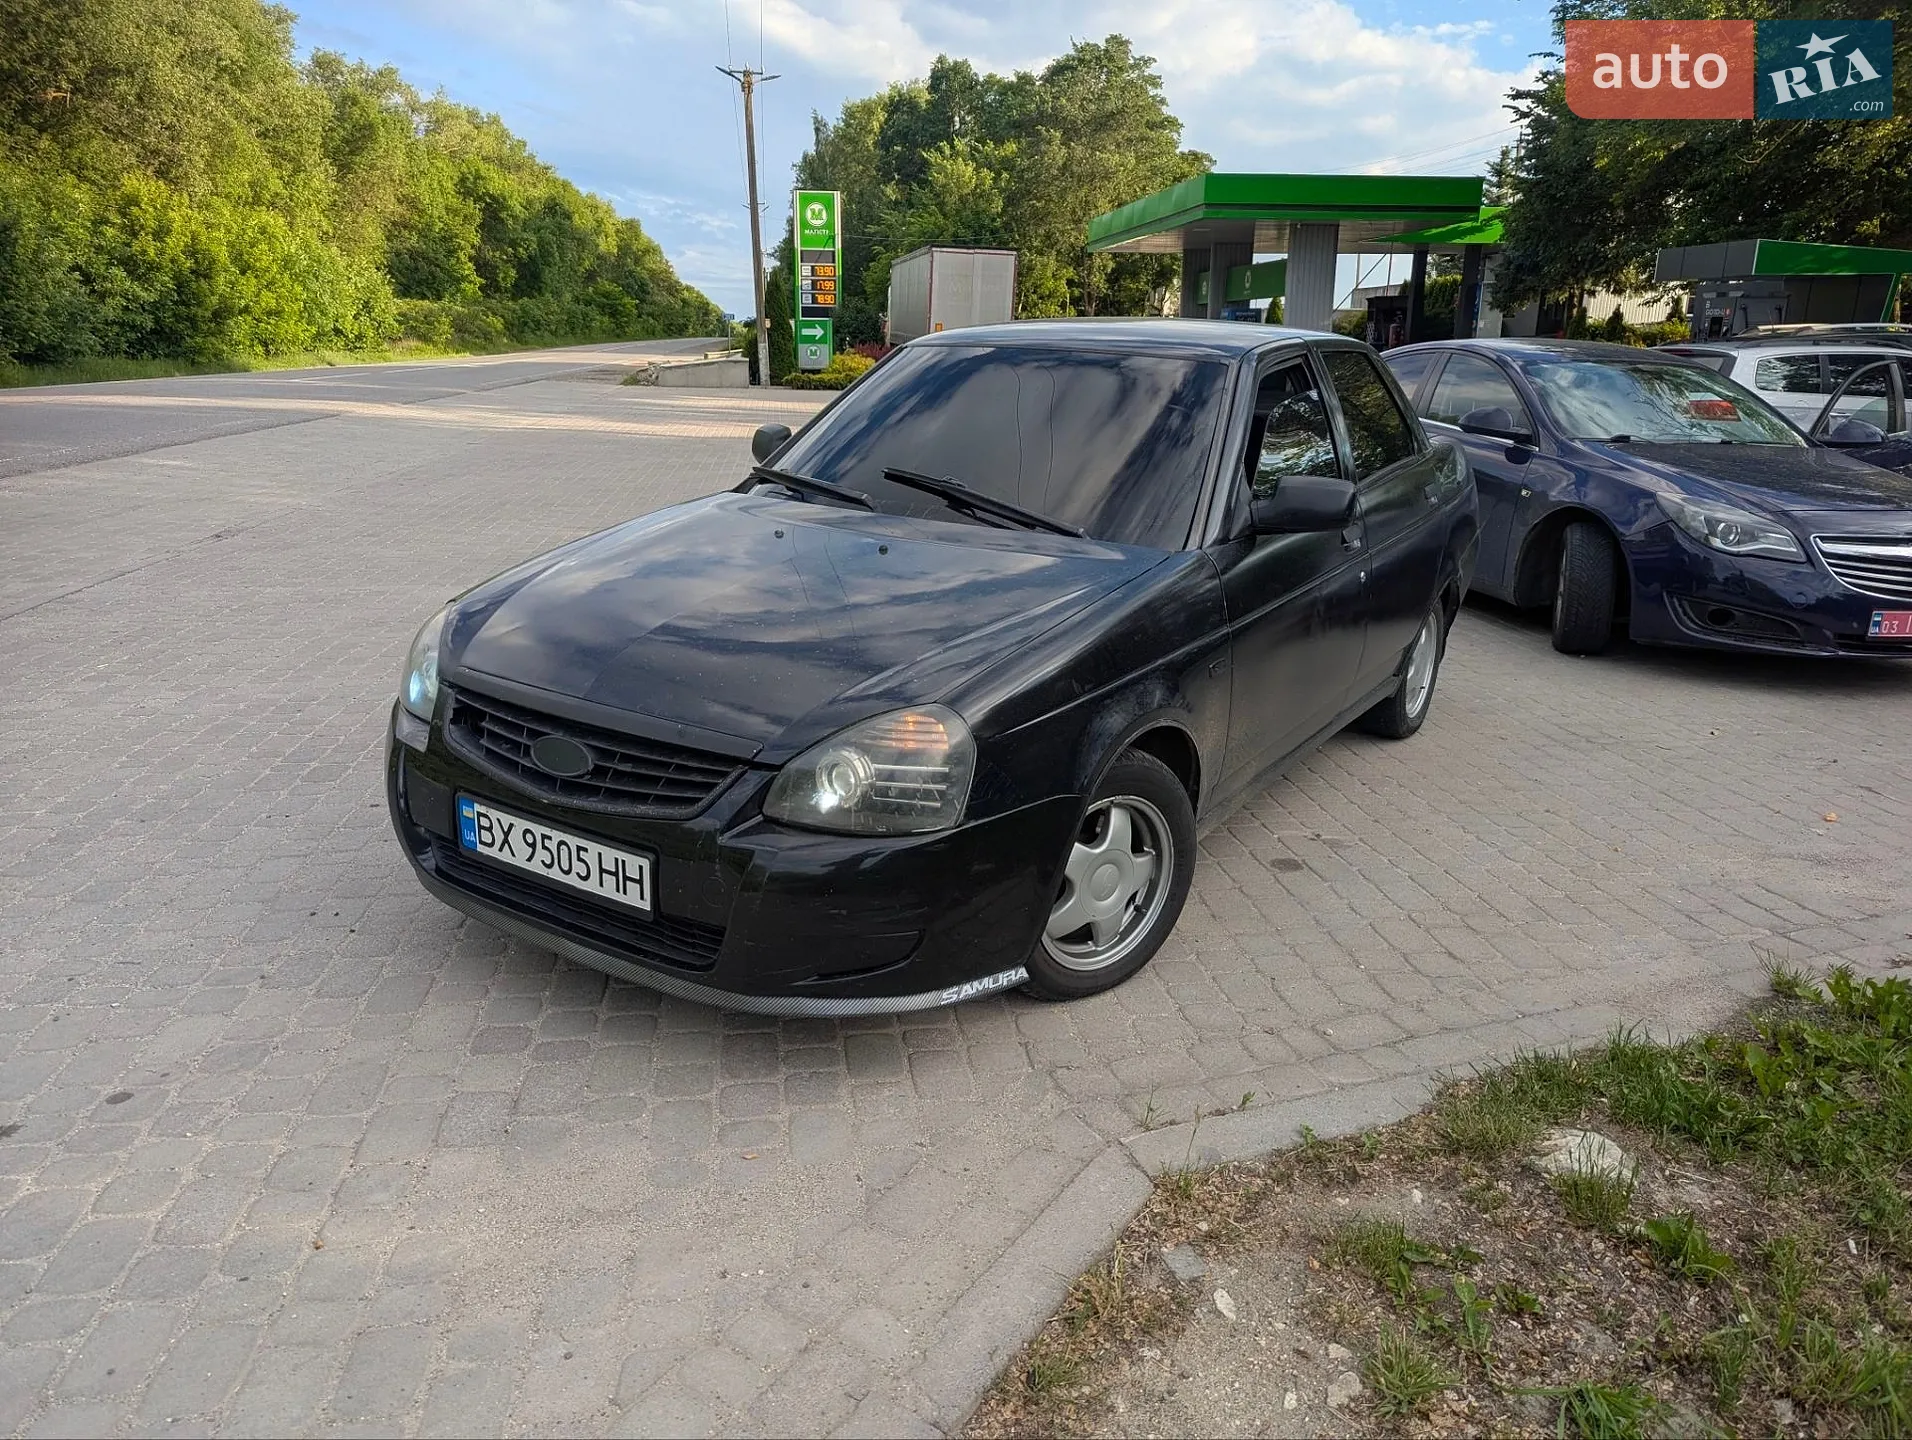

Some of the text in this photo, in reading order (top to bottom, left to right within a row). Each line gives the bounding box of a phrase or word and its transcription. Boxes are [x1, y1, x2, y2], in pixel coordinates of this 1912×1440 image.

[1882, 620, 1899, 633] 03
[464, 829, 476, 843] UA
[476, 811, 645, 901] BX 9505 HH
